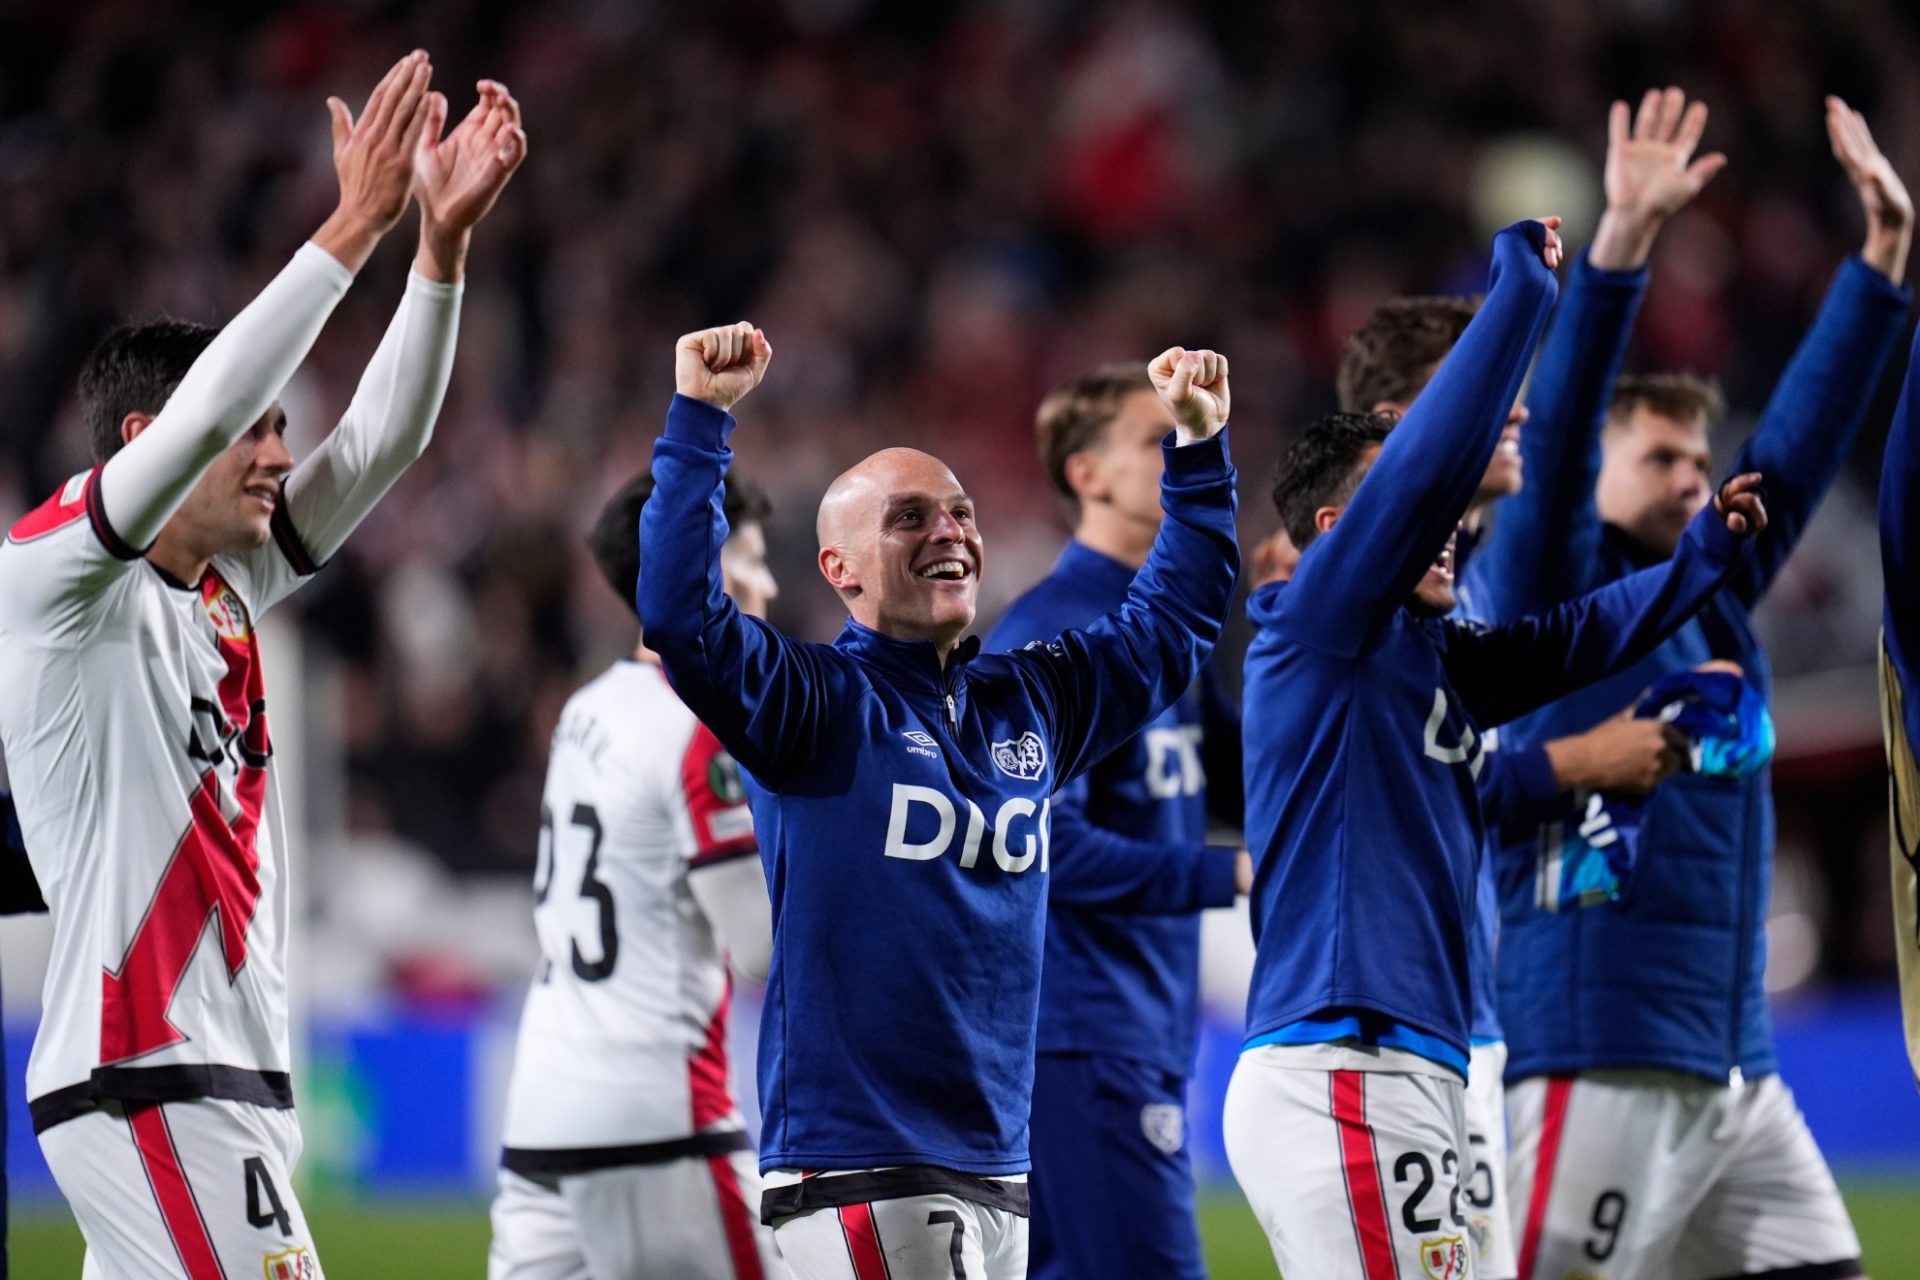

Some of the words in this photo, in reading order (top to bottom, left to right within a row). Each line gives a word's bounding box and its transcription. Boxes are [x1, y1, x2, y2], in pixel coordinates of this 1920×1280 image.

[906, 746, 938, 759] umbro
[884, 783, 1050, 873] DIGI
[243, 1156, 293, 1237] 4
[1585, 1190, 1627, 1264] 9
[927, 1210, 967, 1280] 7
